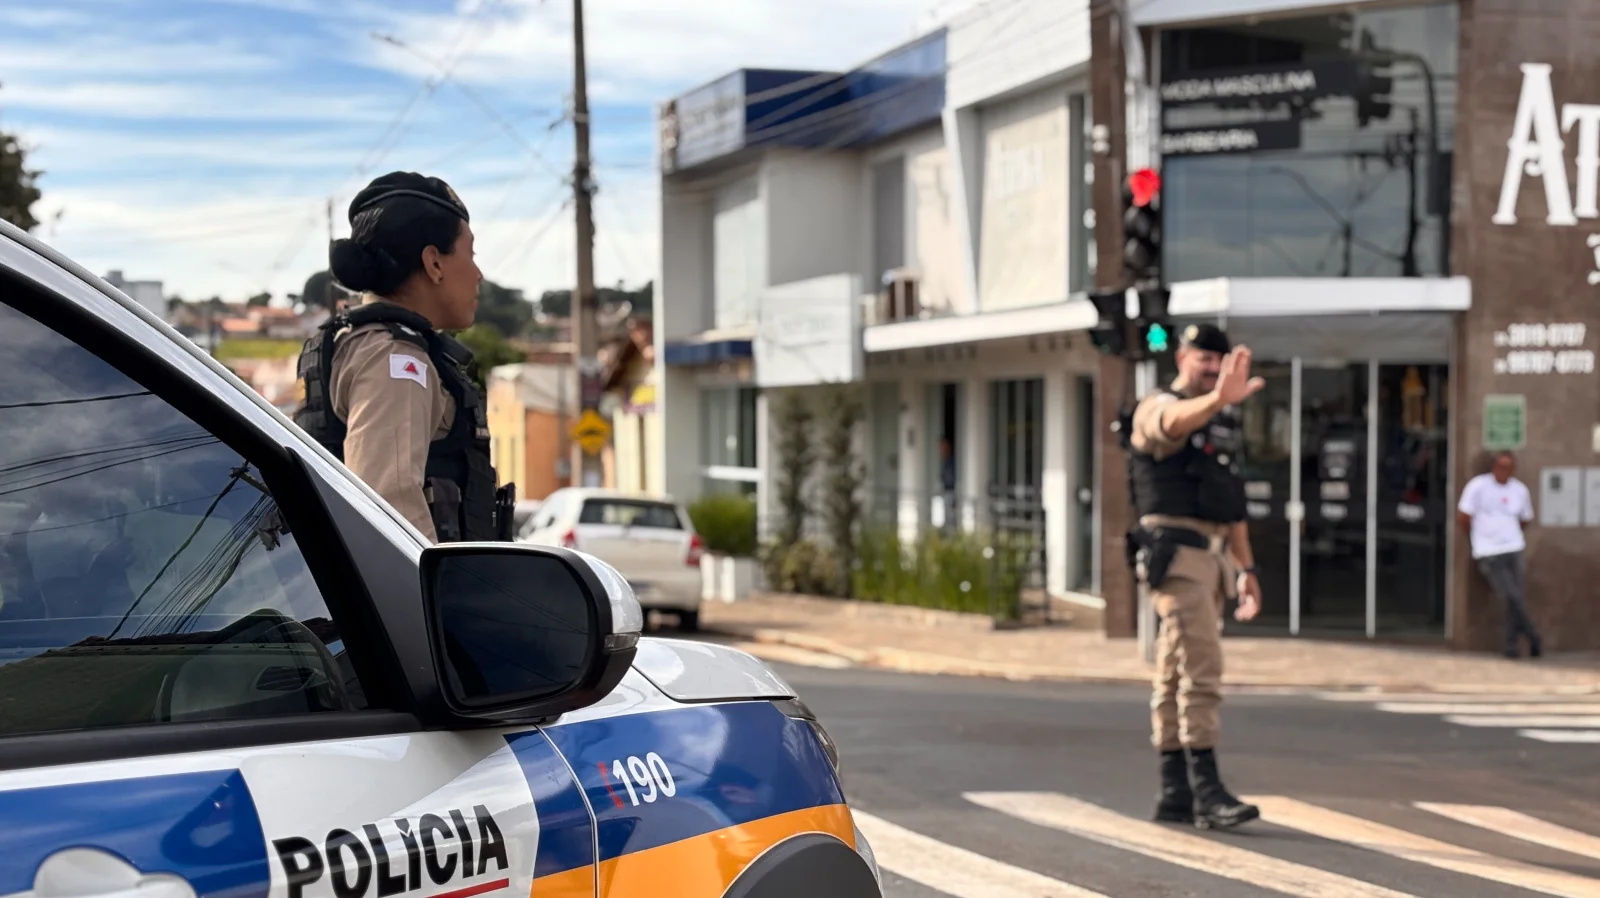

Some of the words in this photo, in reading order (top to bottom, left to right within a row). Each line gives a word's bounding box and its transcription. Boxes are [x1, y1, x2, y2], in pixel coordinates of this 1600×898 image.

[1161, 78, 1212, 101] MODA
[1213, 69, 1317, 97] MASCULINA
[1161, 128, 1259, 154] BARBEARIA
[612, 751, 676, 807] 190
[272, 804, 509, 898] POLÍCIA
